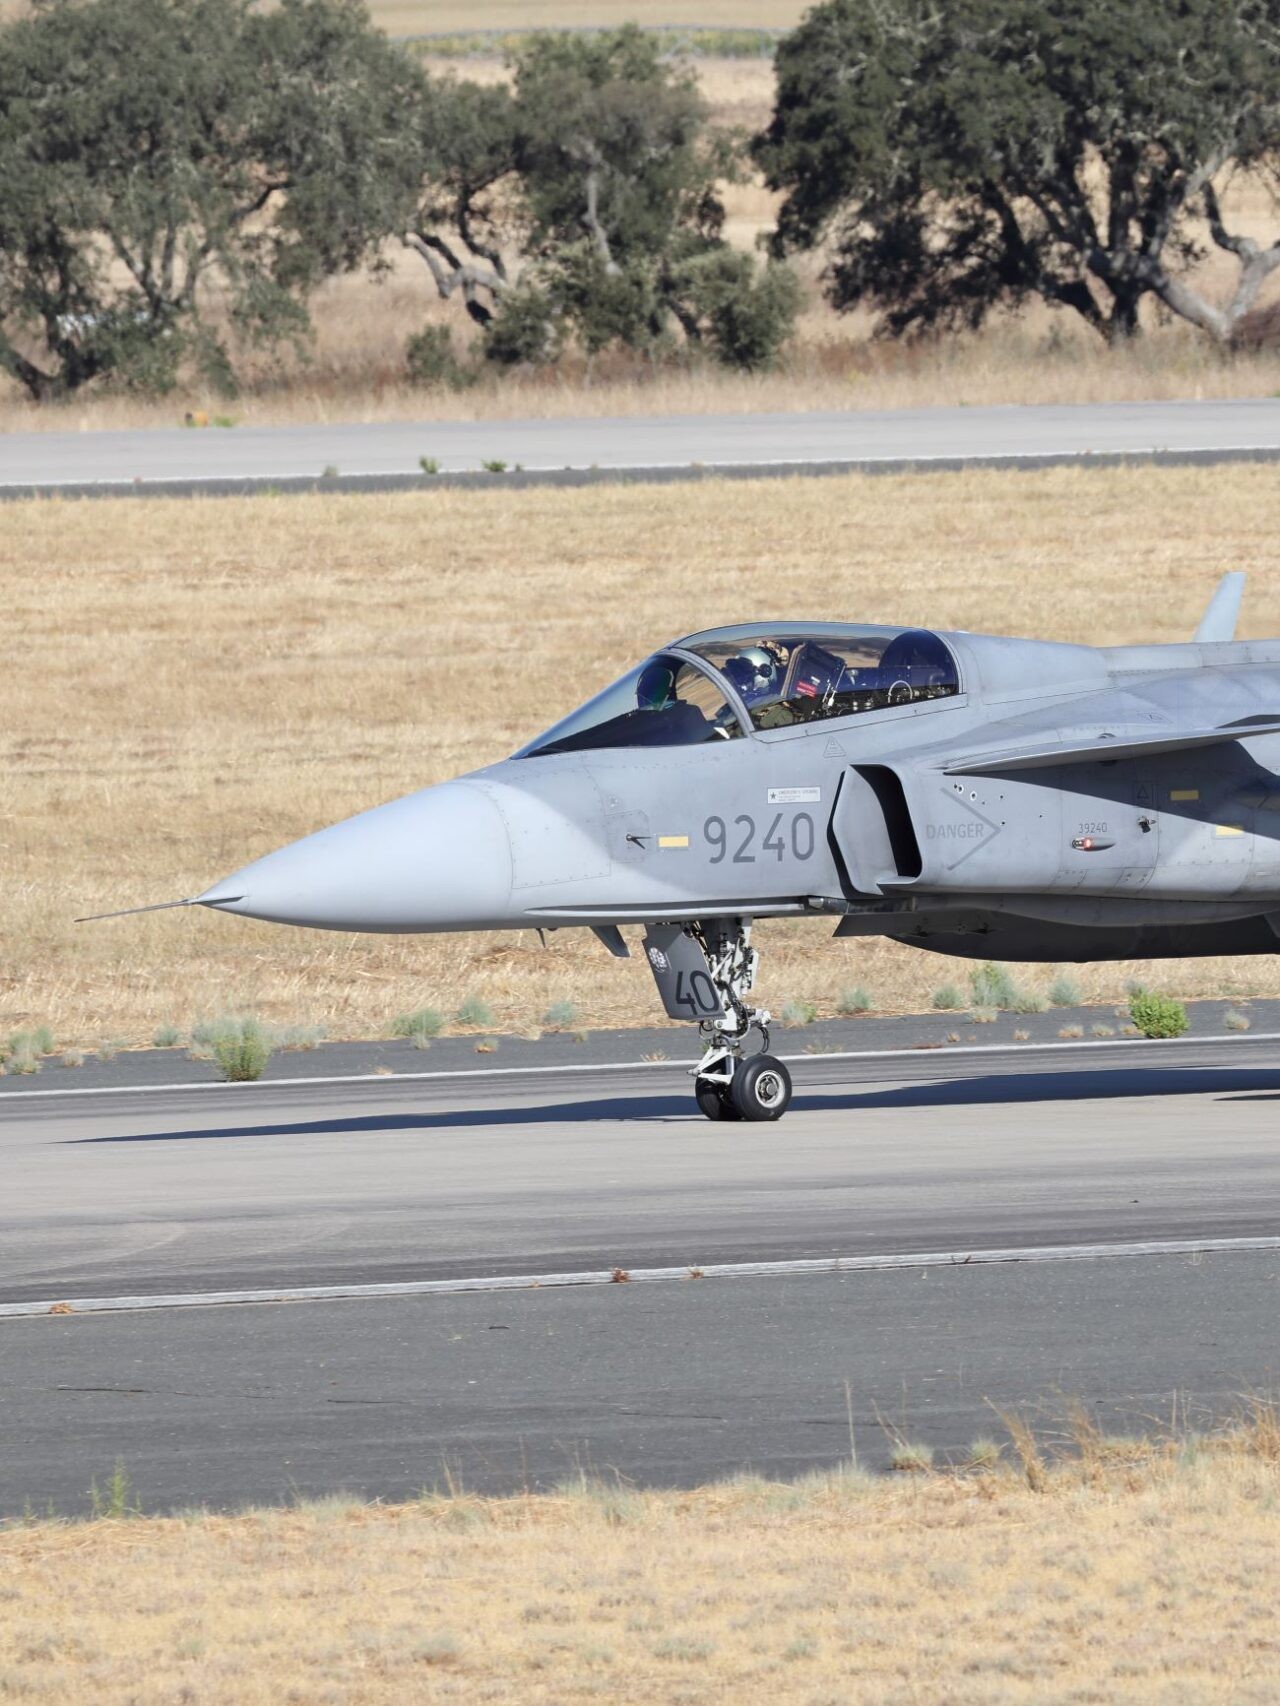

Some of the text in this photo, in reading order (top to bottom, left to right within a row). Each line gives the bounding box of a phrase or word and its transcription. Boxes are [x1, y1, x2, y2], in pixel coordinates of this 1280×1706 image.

[703, 812, 815, 864] 9240
[926, 823, 985, 840] DANGER
[1078, 822, 1108, 833] 39240
[676, 970, 720, 1015] 40
